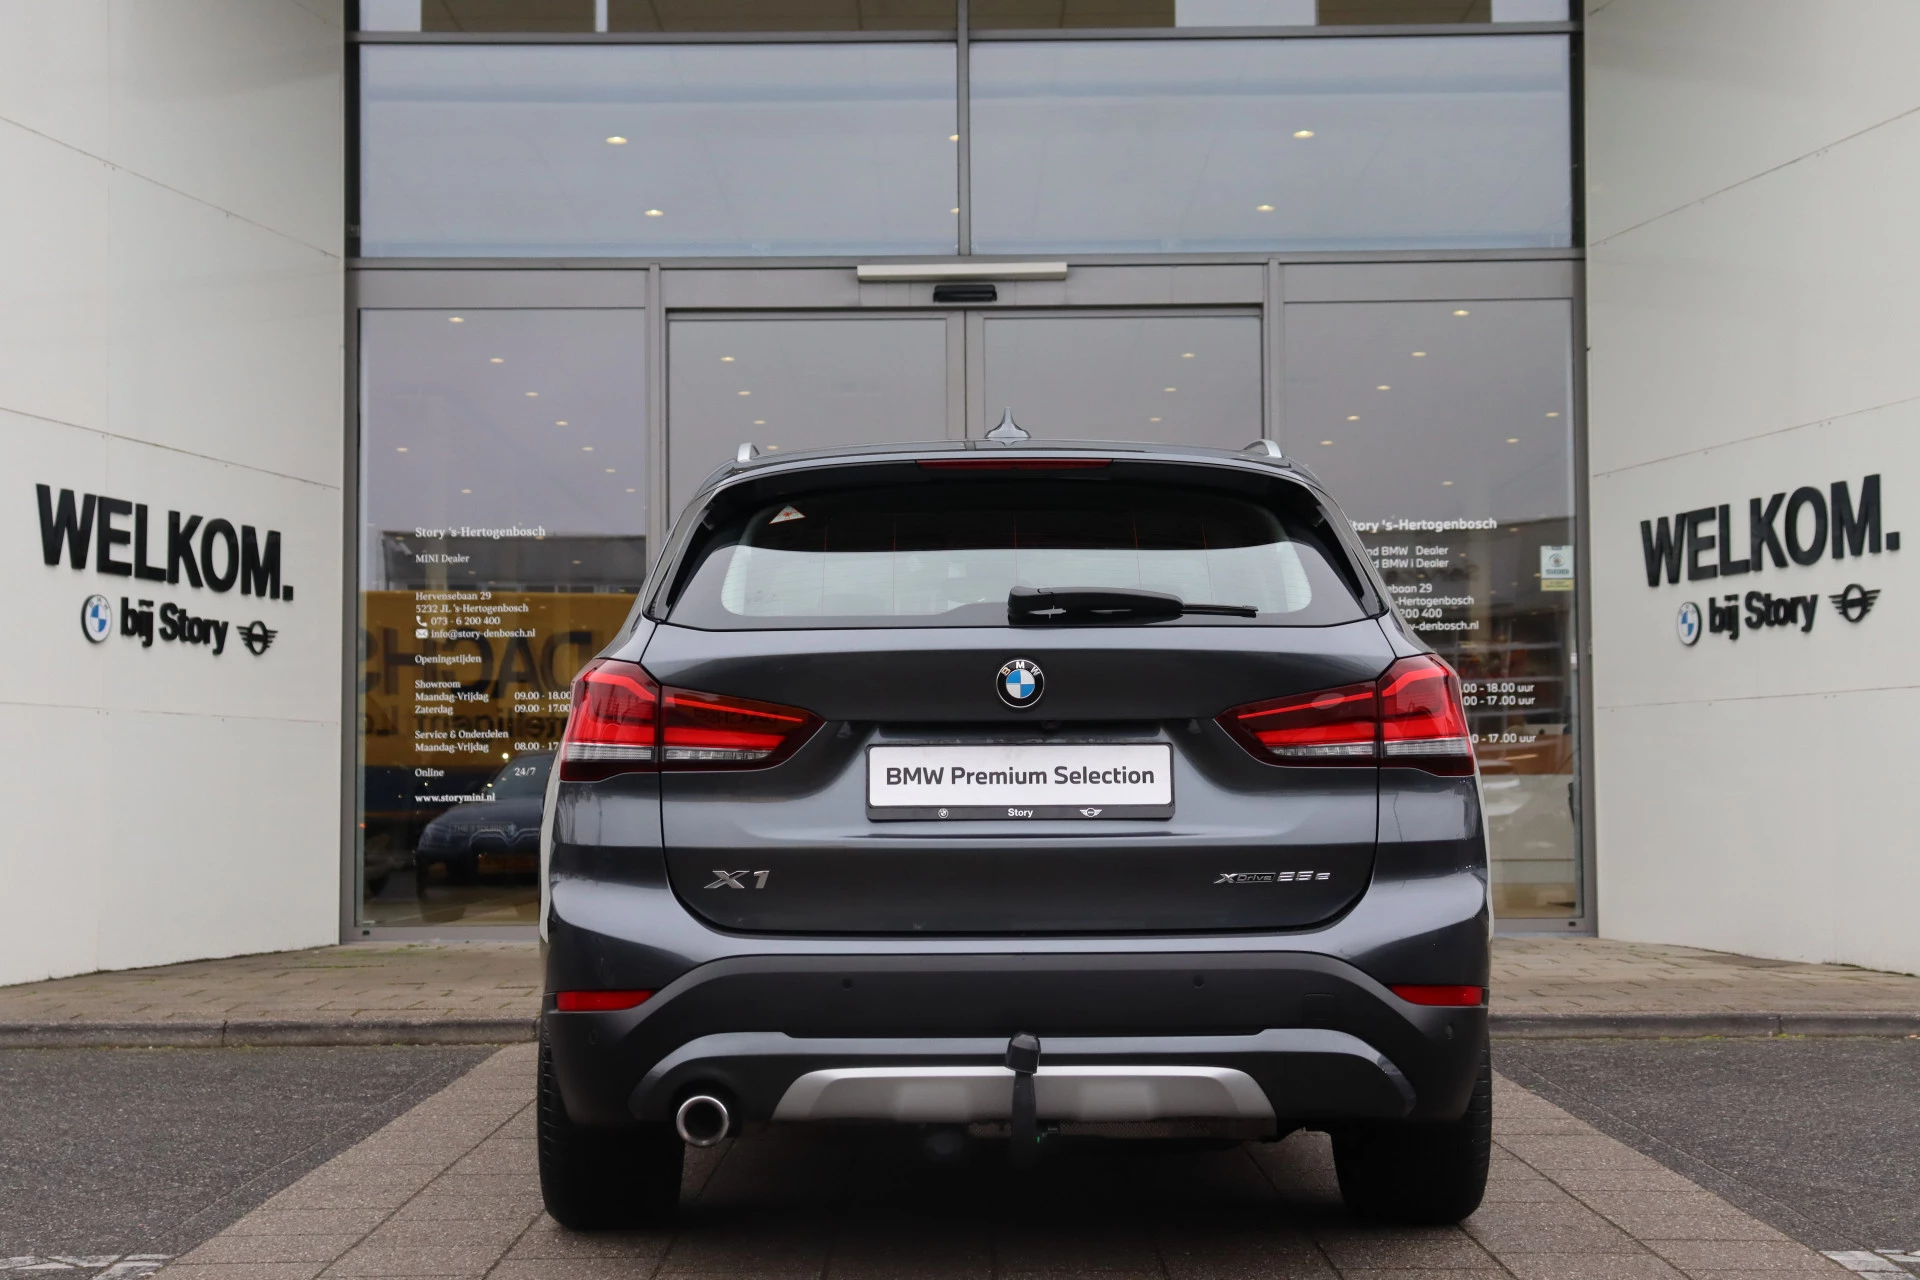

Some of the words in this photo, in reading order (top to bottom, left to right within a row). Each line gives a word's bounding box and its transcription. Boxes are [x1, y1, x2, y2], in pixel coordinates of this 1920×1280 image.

[1350, 520, 1379, 532] tory
[1640, 473, 1900, 588] WELKOM.
[415, 527, 445, 539] Story
[36, 483, 294, 602] WELKOM.
[1381, 546, 1408, 556] BMW
[1415, 545, 1449, 556] Dealer
[415, 554, 439, 563] MINI
[441, 554, 470, 563] Dealer
[1382, 558, 1409, 568] BMW
[1416, 558, 1450, 568] Dealer
[1419, 583, 1433, 593] 29
[415, 592, 478, 601] Hervensebaan
[480, 591, 491, 600] 29
[415, 604, 438, 614] 5232
[440, 605, 451, 613] JL
[1422, 608, 1442, 618] 400
[1745, 591, 1818, 633] Story
[431, 617, 448, 626] 073
[455, 617, 462, 625] 6
[464, 617, 481, 625] 200
[483, 616, 500, 625] 400
[159, 602, 229, 655] Story
[431, 629, 536, 640] info@story-denbosch.nl
[415, 654, 482, 666] Openingstijden
[415, 680, 461, 689] Showroom
[1486, 683, 1515, 692] 18.00
[1517, 684, 1535, 692] uur
[415, 691, 489, 703] Maandag-Vrijdag
[514, 691, 540, 700] 09.00
[548, 691, 571, 700] 18.00
[1517, 697, 1536, 705] uur
[415, 704, 454, 716] Zaterdag
[514, 704, 540, 713] 09.00
[415, 730, 448, 739] Service
[458, 729, 509, 739] Onderdelen
[1519, 735, 1537, 743] uur
[415, 742, 489, 754] Maandag-Vrijdag
[514, 742, 540, 751] 08.00
[415, 768, 445, 777] Online
[514, 767, 536, 777] 24/7
[886, 767, 944, 785] BMW
[951, 766, 1047, 785] Premium
[1054, 765, 1154, 785] Selection
[415, 793, 496, 803] www.storymini.nl
[1007, 808, 1033, 818] Story
[703, 870, 770, 889] X1
